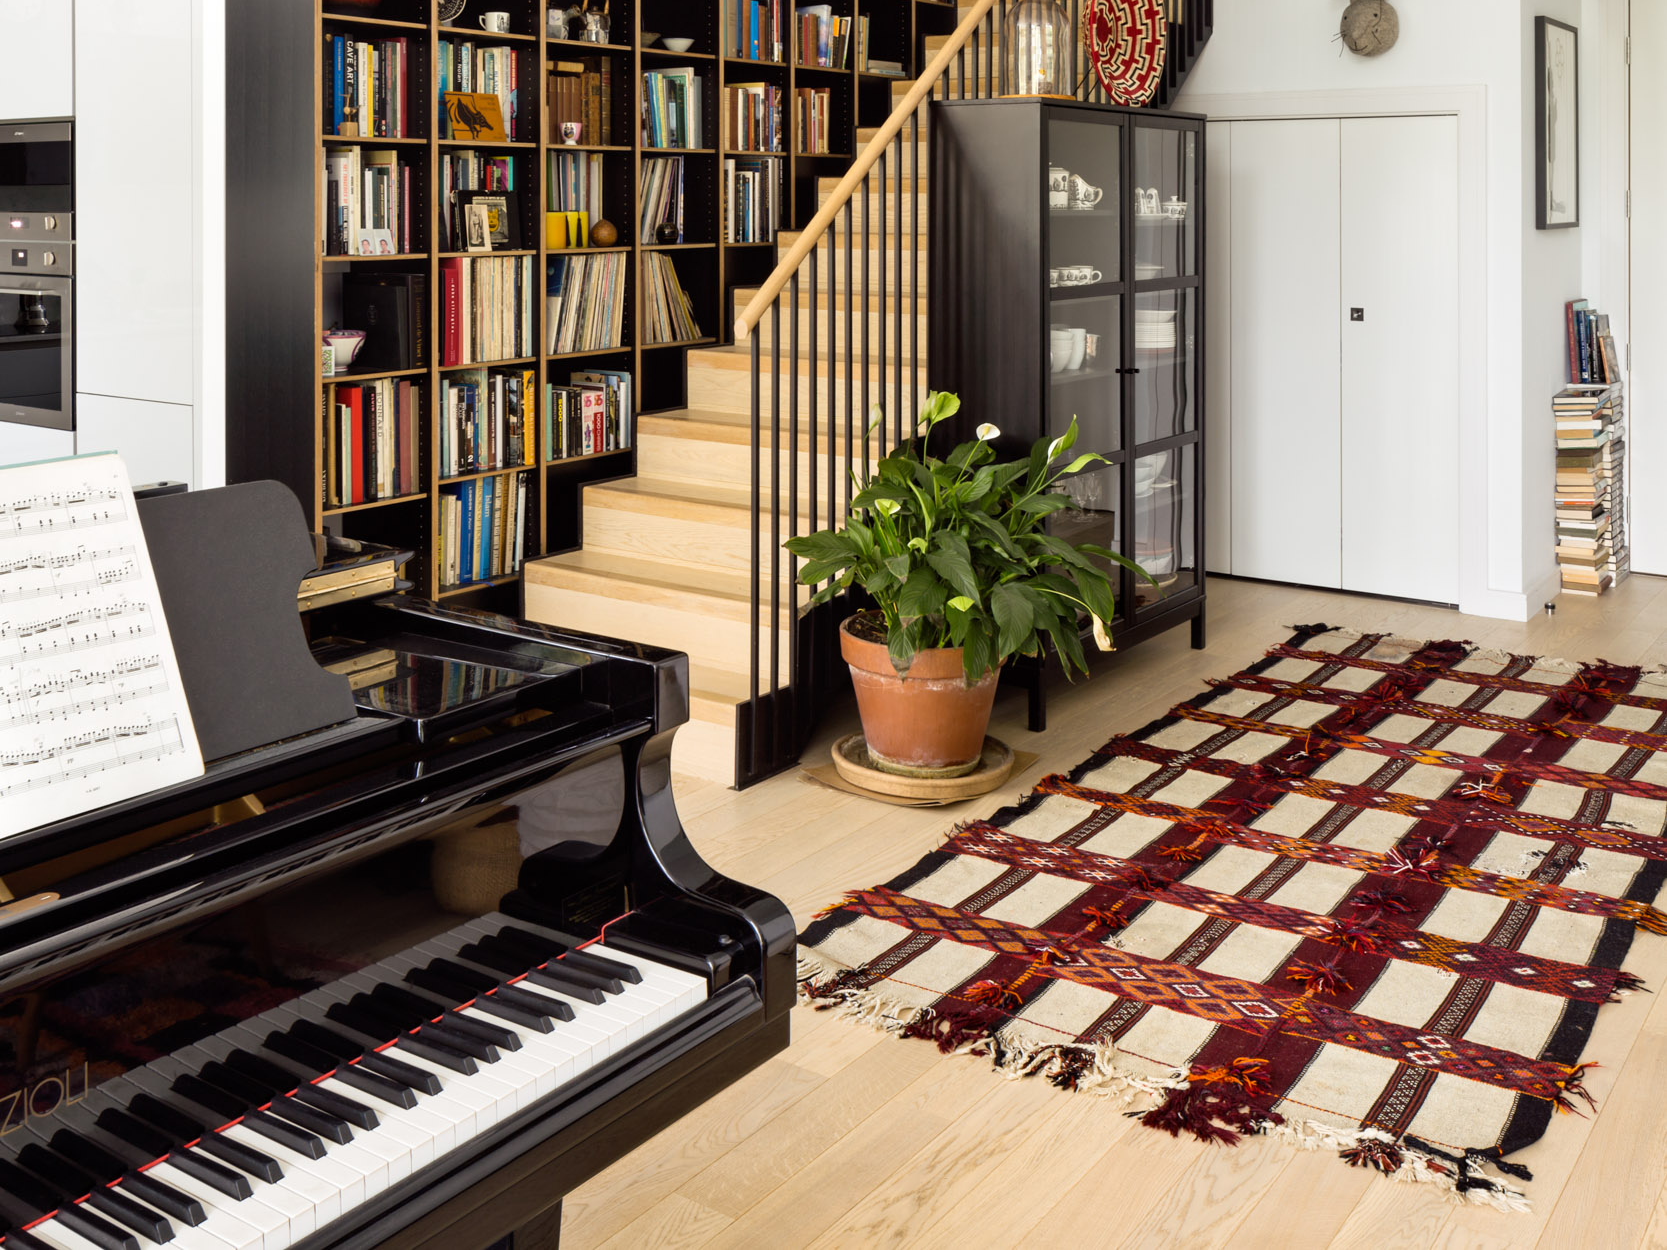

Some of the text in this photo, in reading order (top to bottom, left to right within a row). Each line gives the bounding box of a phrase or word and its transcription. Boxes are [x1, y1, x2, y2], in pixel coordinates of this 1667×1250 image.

[346, 40, 354, 84] CAVE ART
[467, 455, 474, 463] 2
[484, 494, 492, 518] Islam
